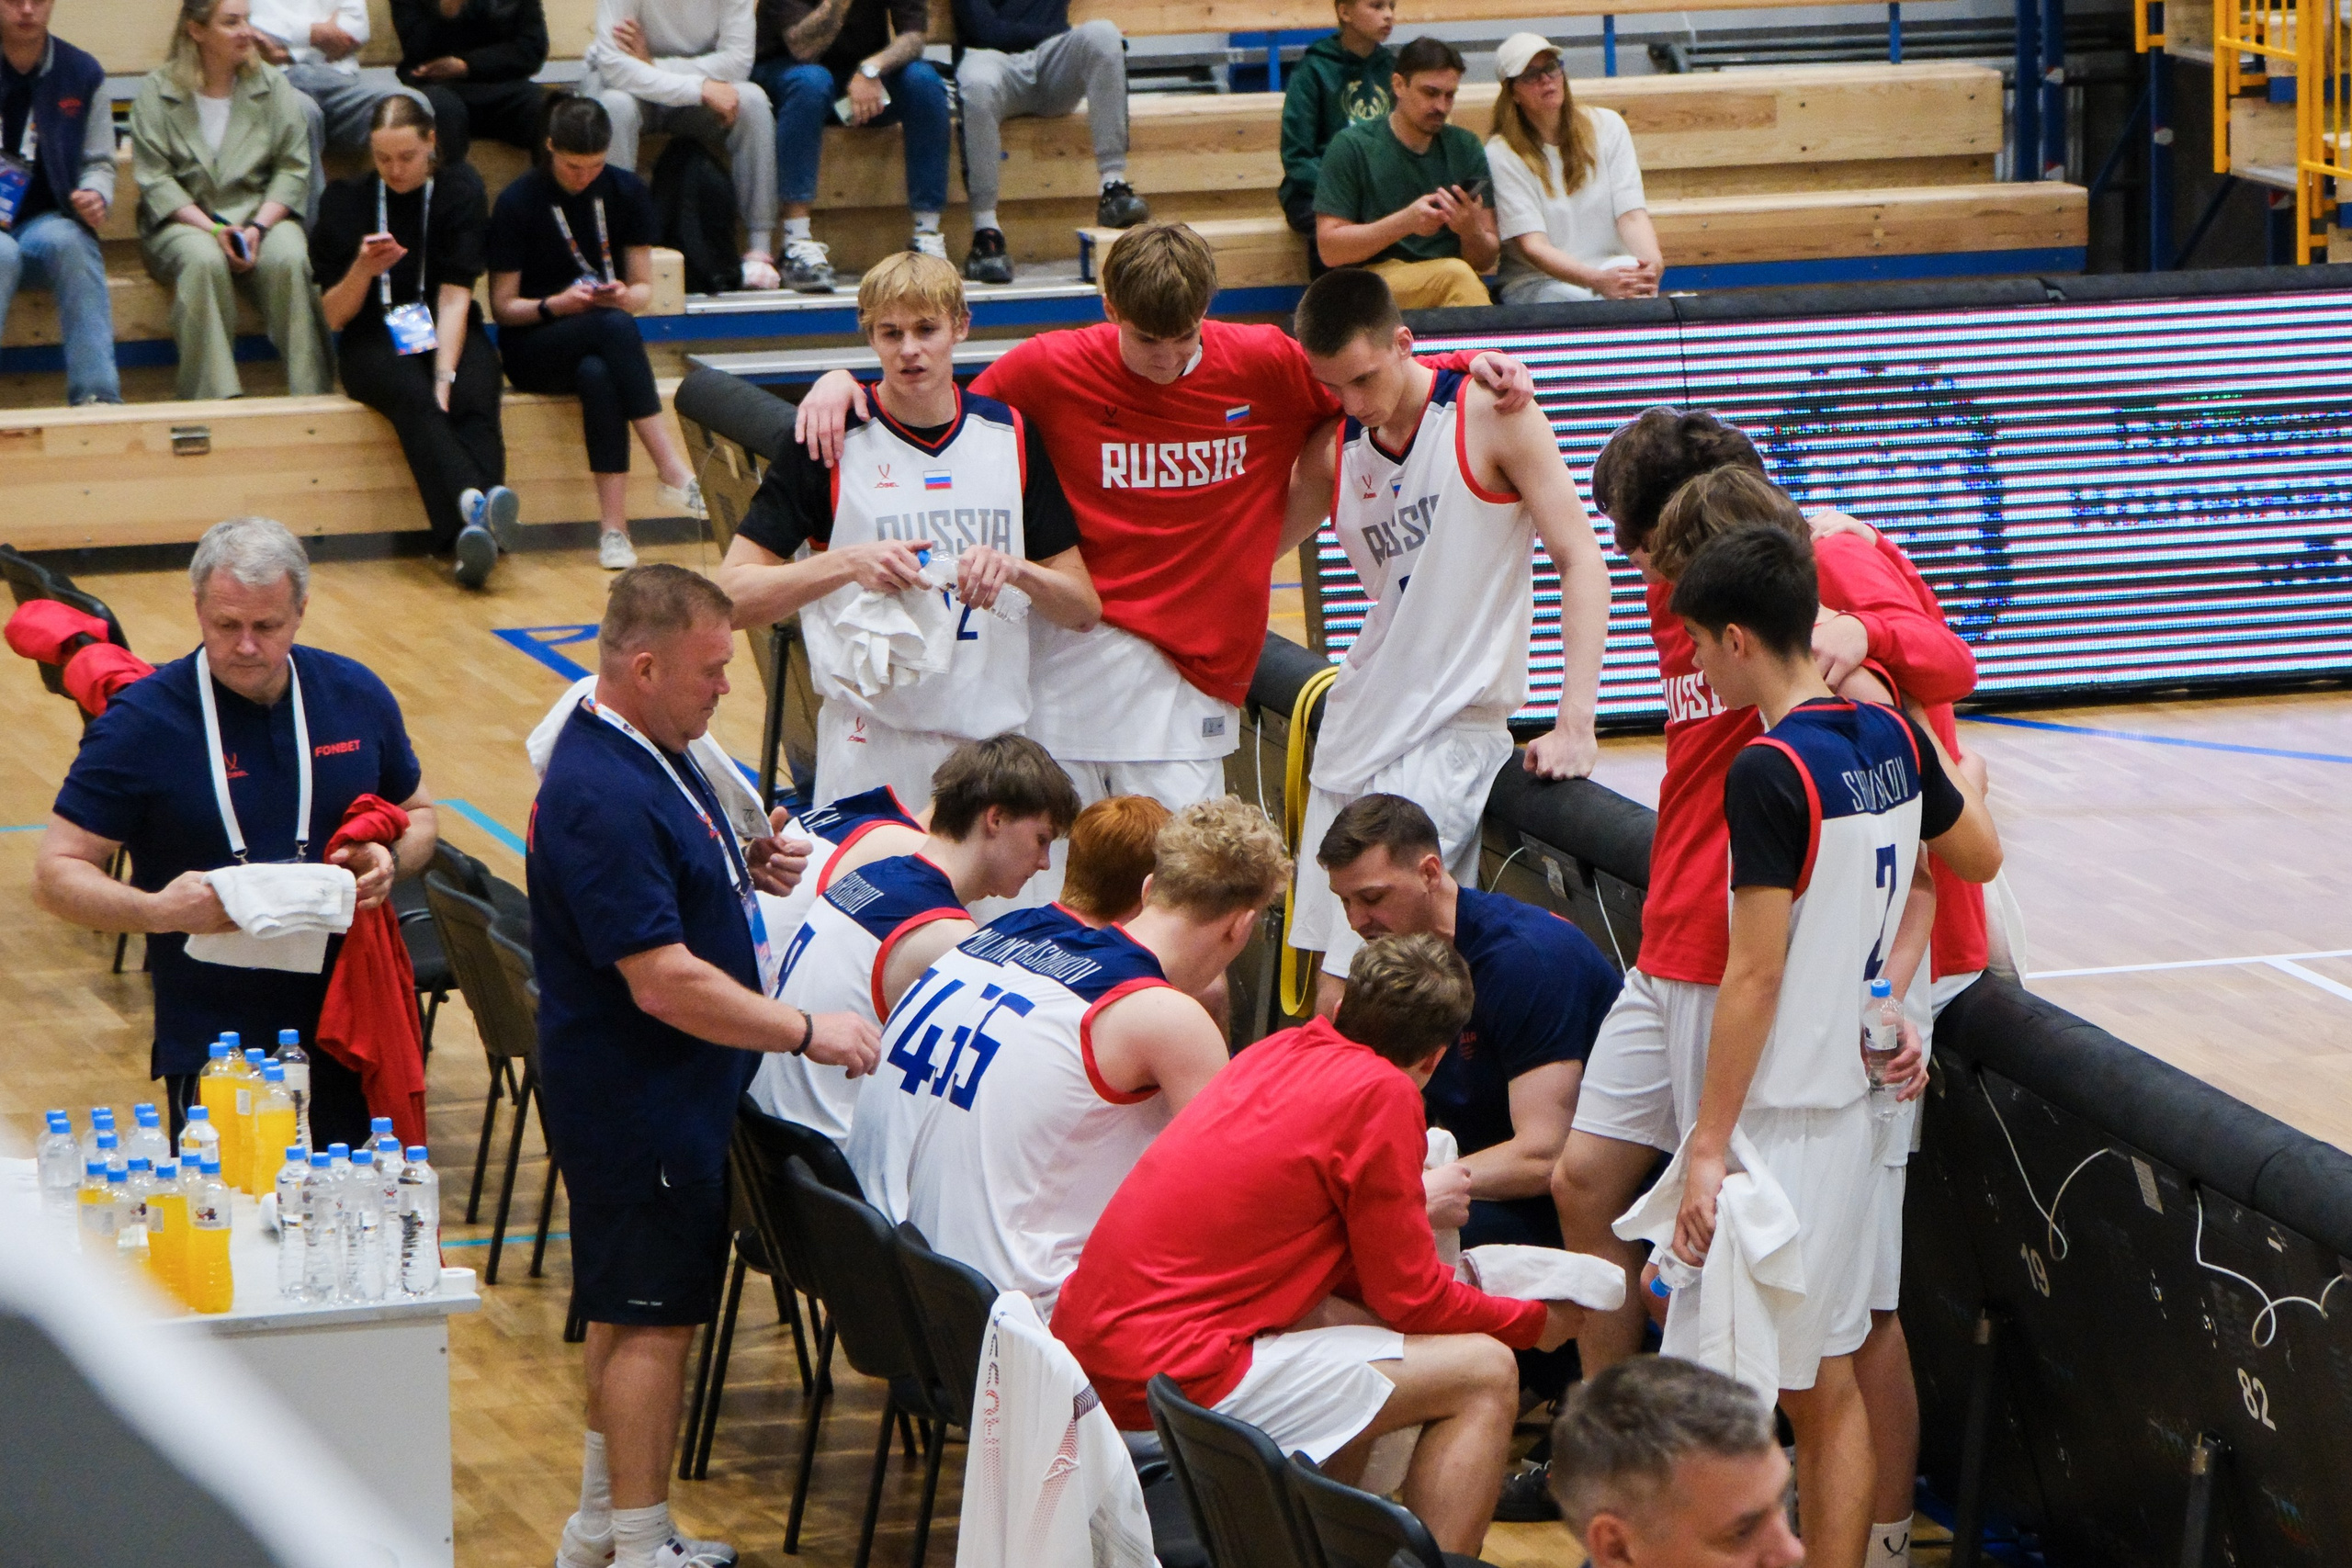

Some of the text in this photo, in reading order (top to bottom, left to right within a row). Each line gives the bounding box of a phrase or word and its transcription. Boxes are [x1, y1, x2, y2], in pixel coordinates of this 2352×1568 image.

[1102, 435, 1248, 489] RUSSIA
[314, 739, 361, 758] FONBET
[2020, 1243, 2052, 1298] 19
[2237, 1367, 2278, 1432] 82
